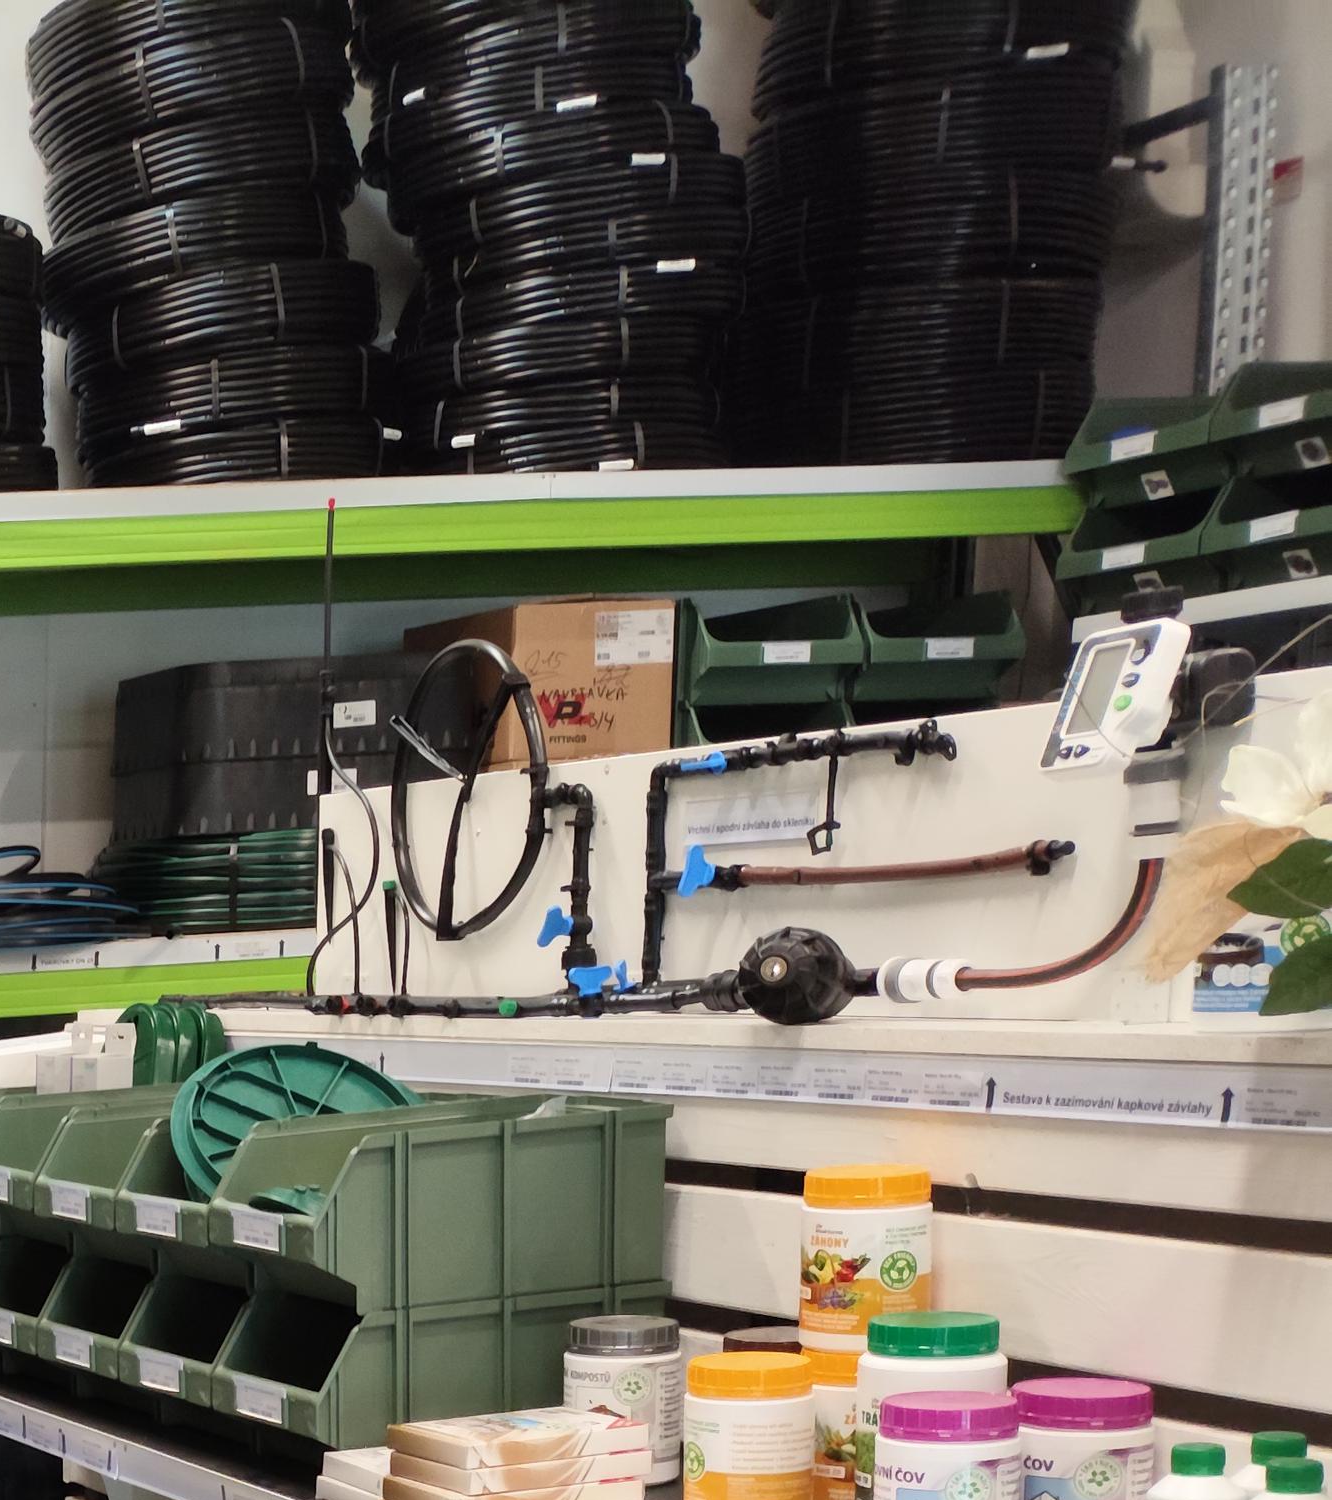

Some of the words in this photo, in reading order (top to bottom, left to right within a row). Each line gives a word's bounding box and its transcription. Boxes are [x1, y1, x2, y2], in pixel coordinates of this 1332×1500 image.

[1002, 1091, 1043, 1105] Sestava
[1045, 1095, 1052, 1106] k
[1053, 1096, 1115, 1110] zazimování
[1116, 1098, 1165, 1114] kapkové
[1166, 1101, 1213, 1118] závlahy
[1023, 1455, 1055, 1472] ČOV
[894, 1464, 926, 1485] ČOV
